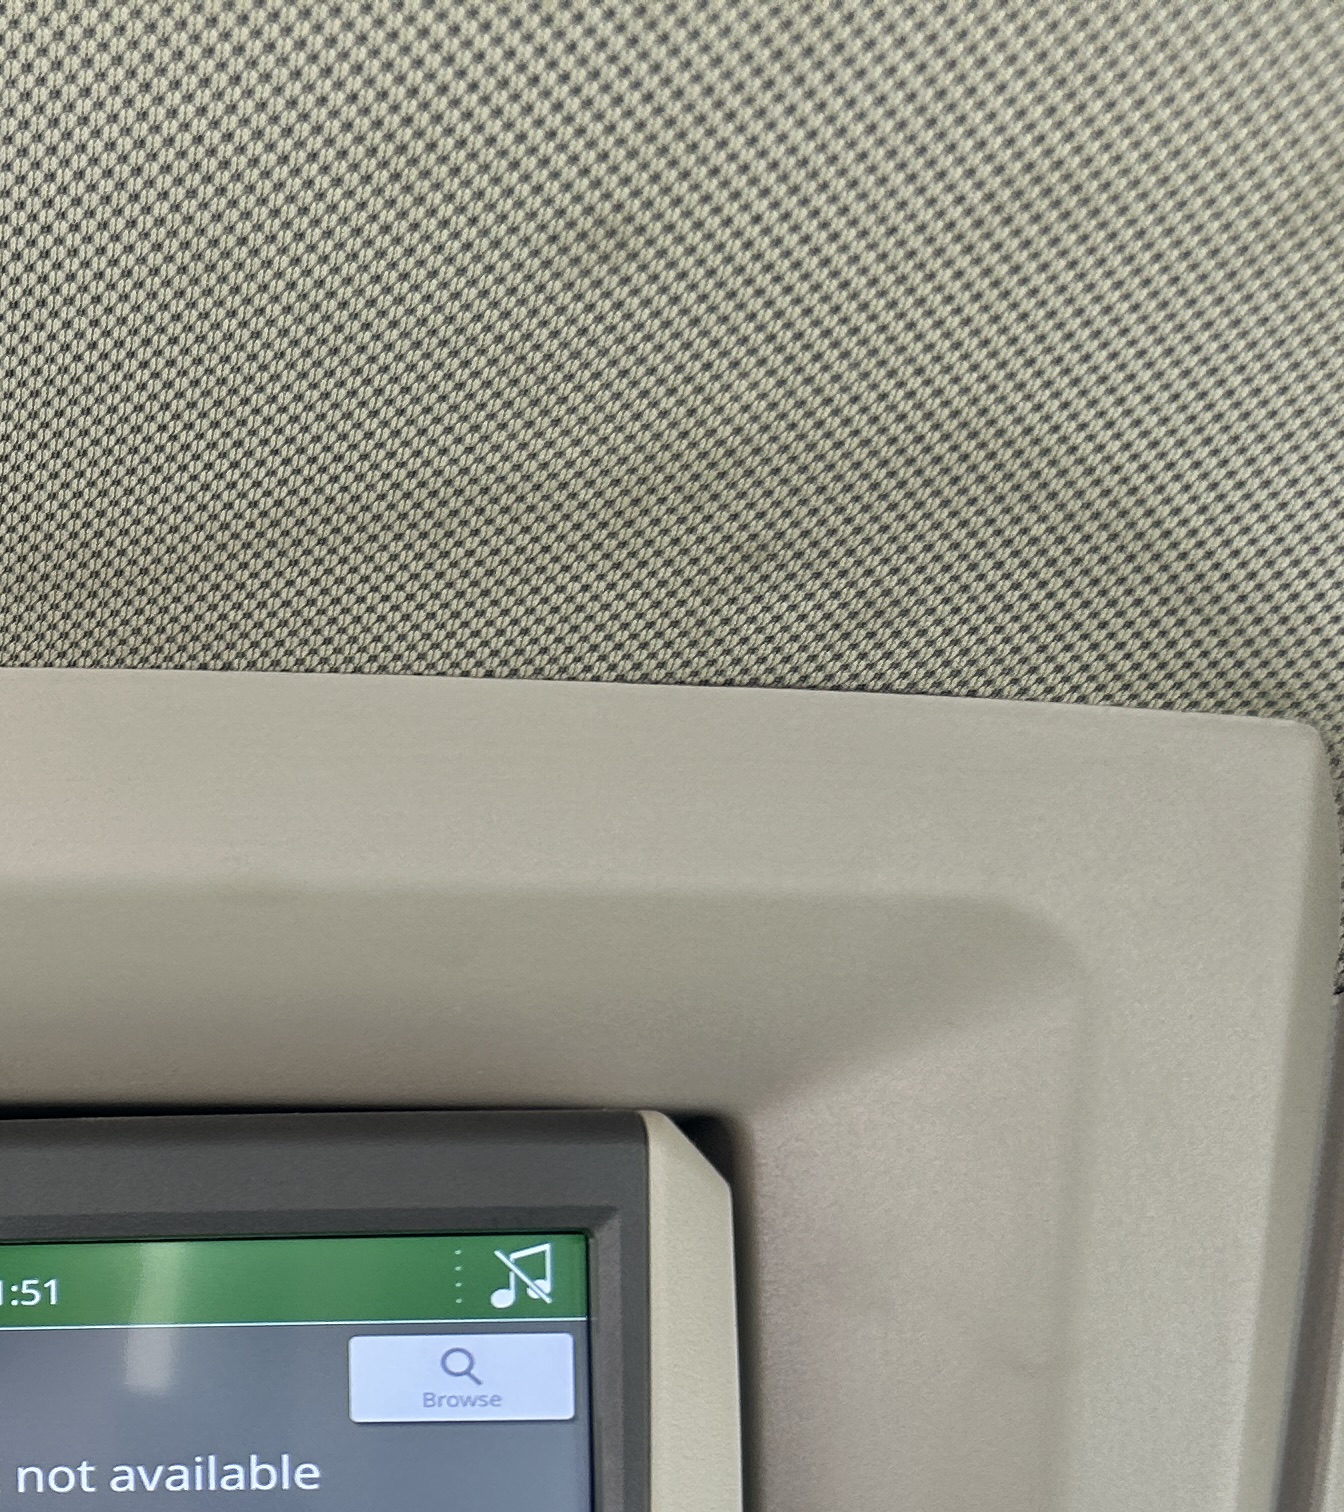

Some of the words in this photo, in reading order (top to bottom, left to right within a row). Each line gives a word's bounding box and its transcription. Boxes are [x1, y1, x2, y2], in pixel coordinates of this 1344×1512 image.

[422, 1391, 503, 1408] Browse
[18, 1460, 96, 1493] not
[109, 1454, 321, 1493] available
